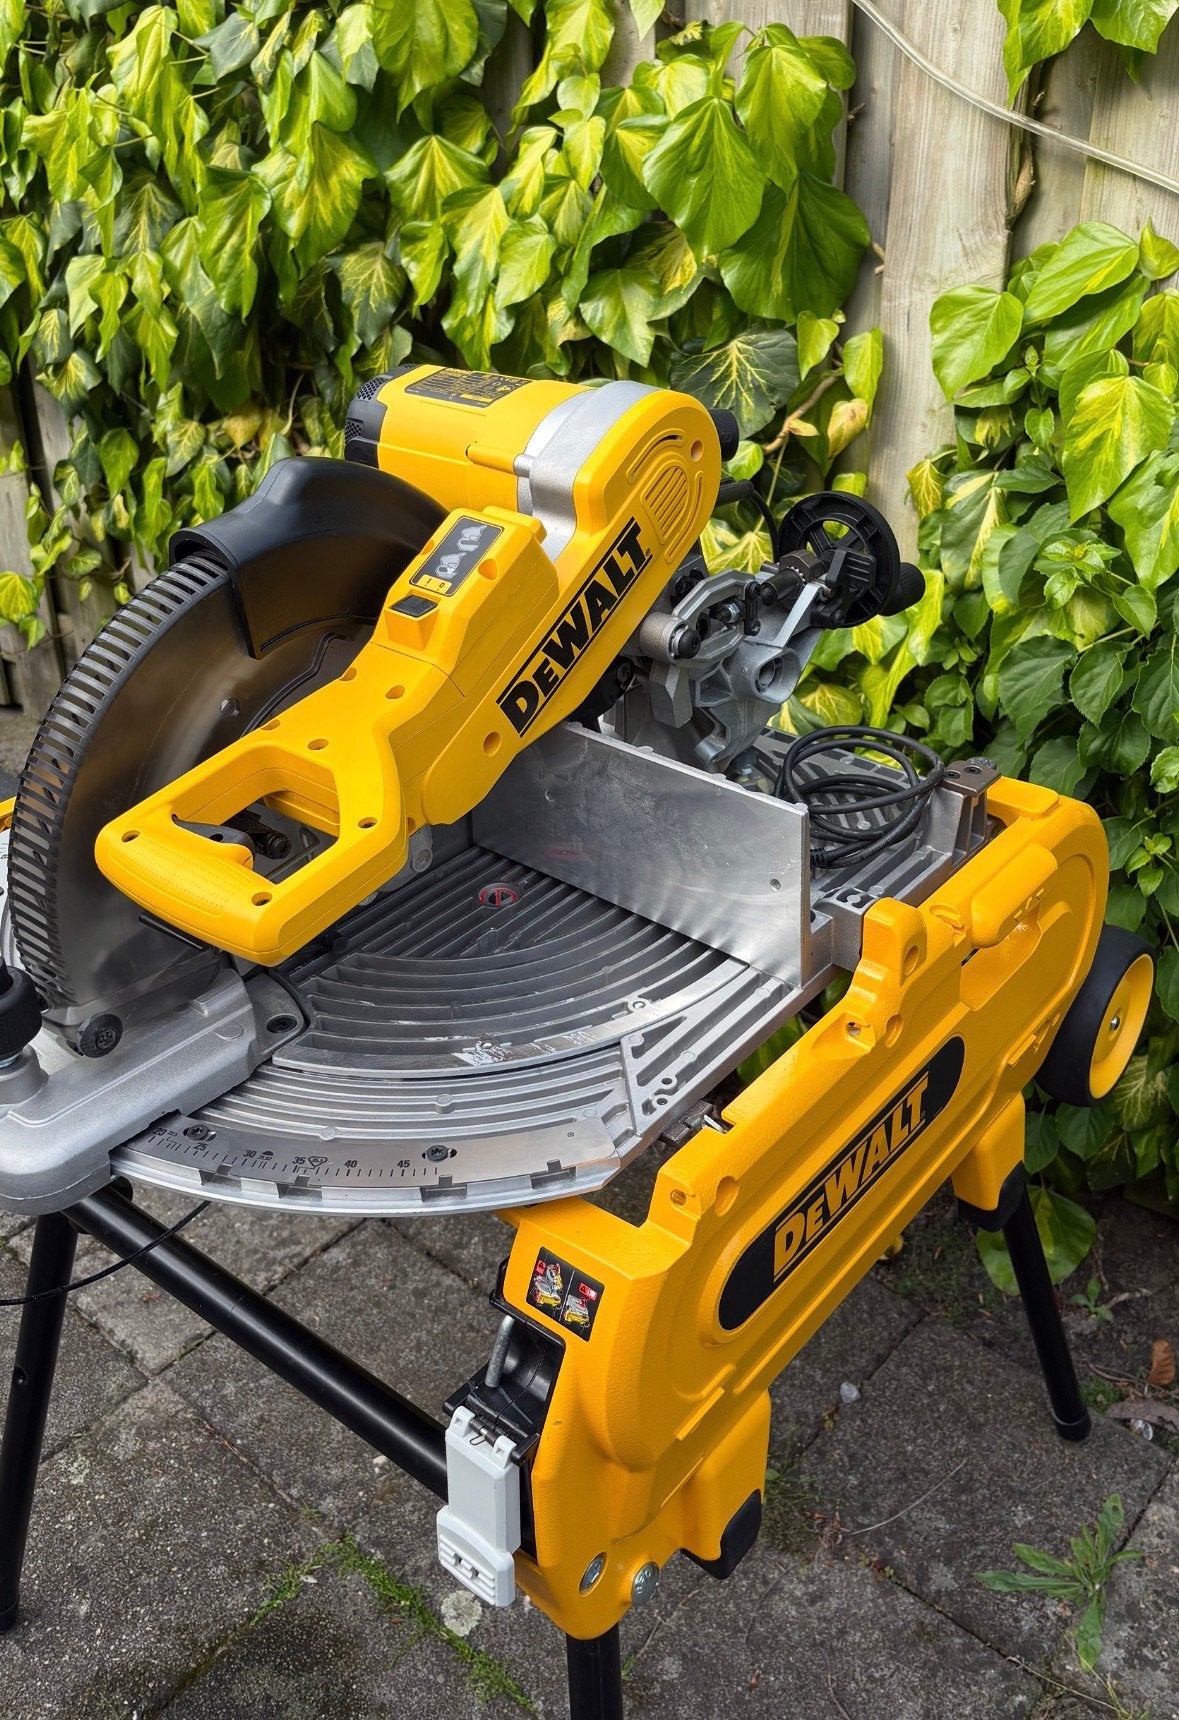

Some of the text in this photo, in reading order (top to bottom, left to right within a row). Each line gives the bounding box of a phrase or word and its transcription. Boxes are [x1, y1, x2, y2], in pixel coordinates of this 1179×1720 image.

[153, 1127, 167, 1136] 20
[193, 1142, 208, 1151] 25
[243, 1149, 257, 1158] 30
[292, 1156, 307, 1165] 35
[344, 1160, 358, 1168] 40
[397, 1159, 411, 1168] 45
